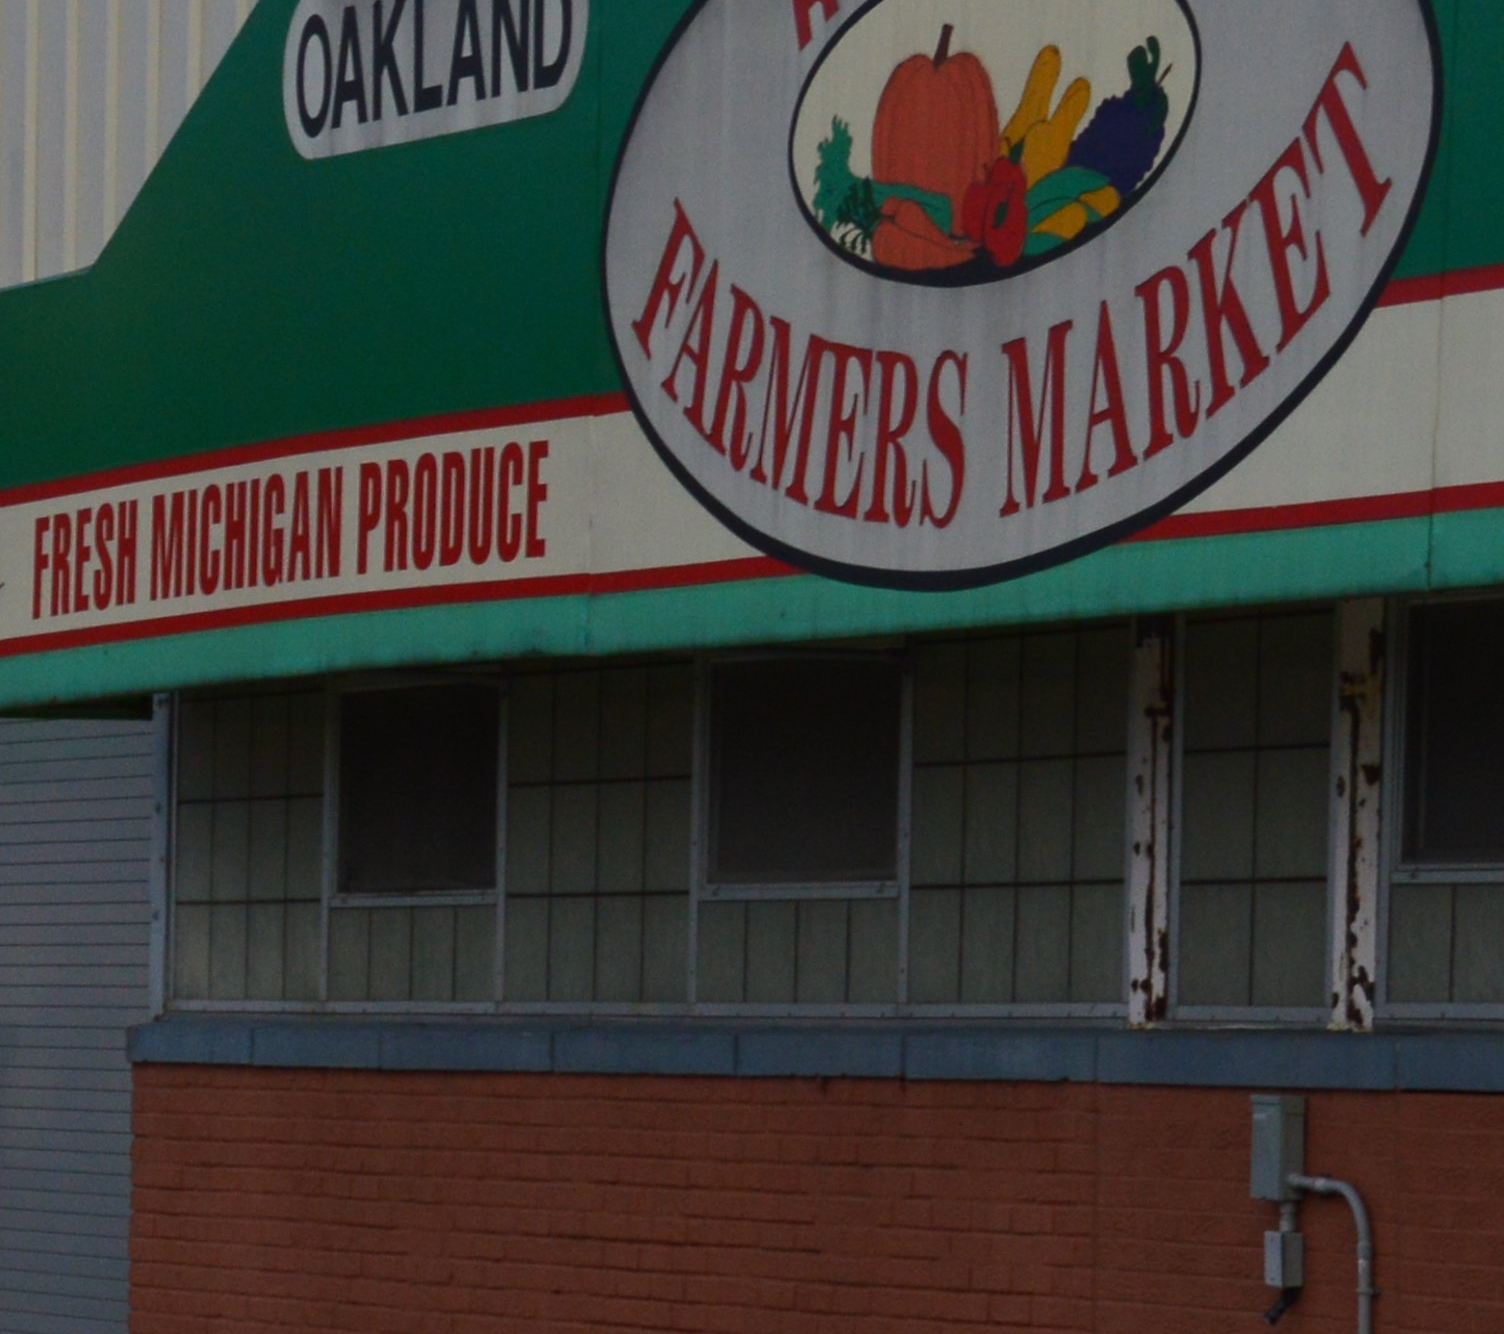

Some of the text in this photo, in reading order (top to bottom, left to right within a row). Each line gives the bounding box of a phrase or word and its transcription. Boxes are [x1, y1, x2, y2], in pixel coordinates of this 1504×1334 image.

[632, 41, 1393, 529] FARMERS MARKET
[32, 440, 549, 620] FRESH MICHIGAN PRODUCE
